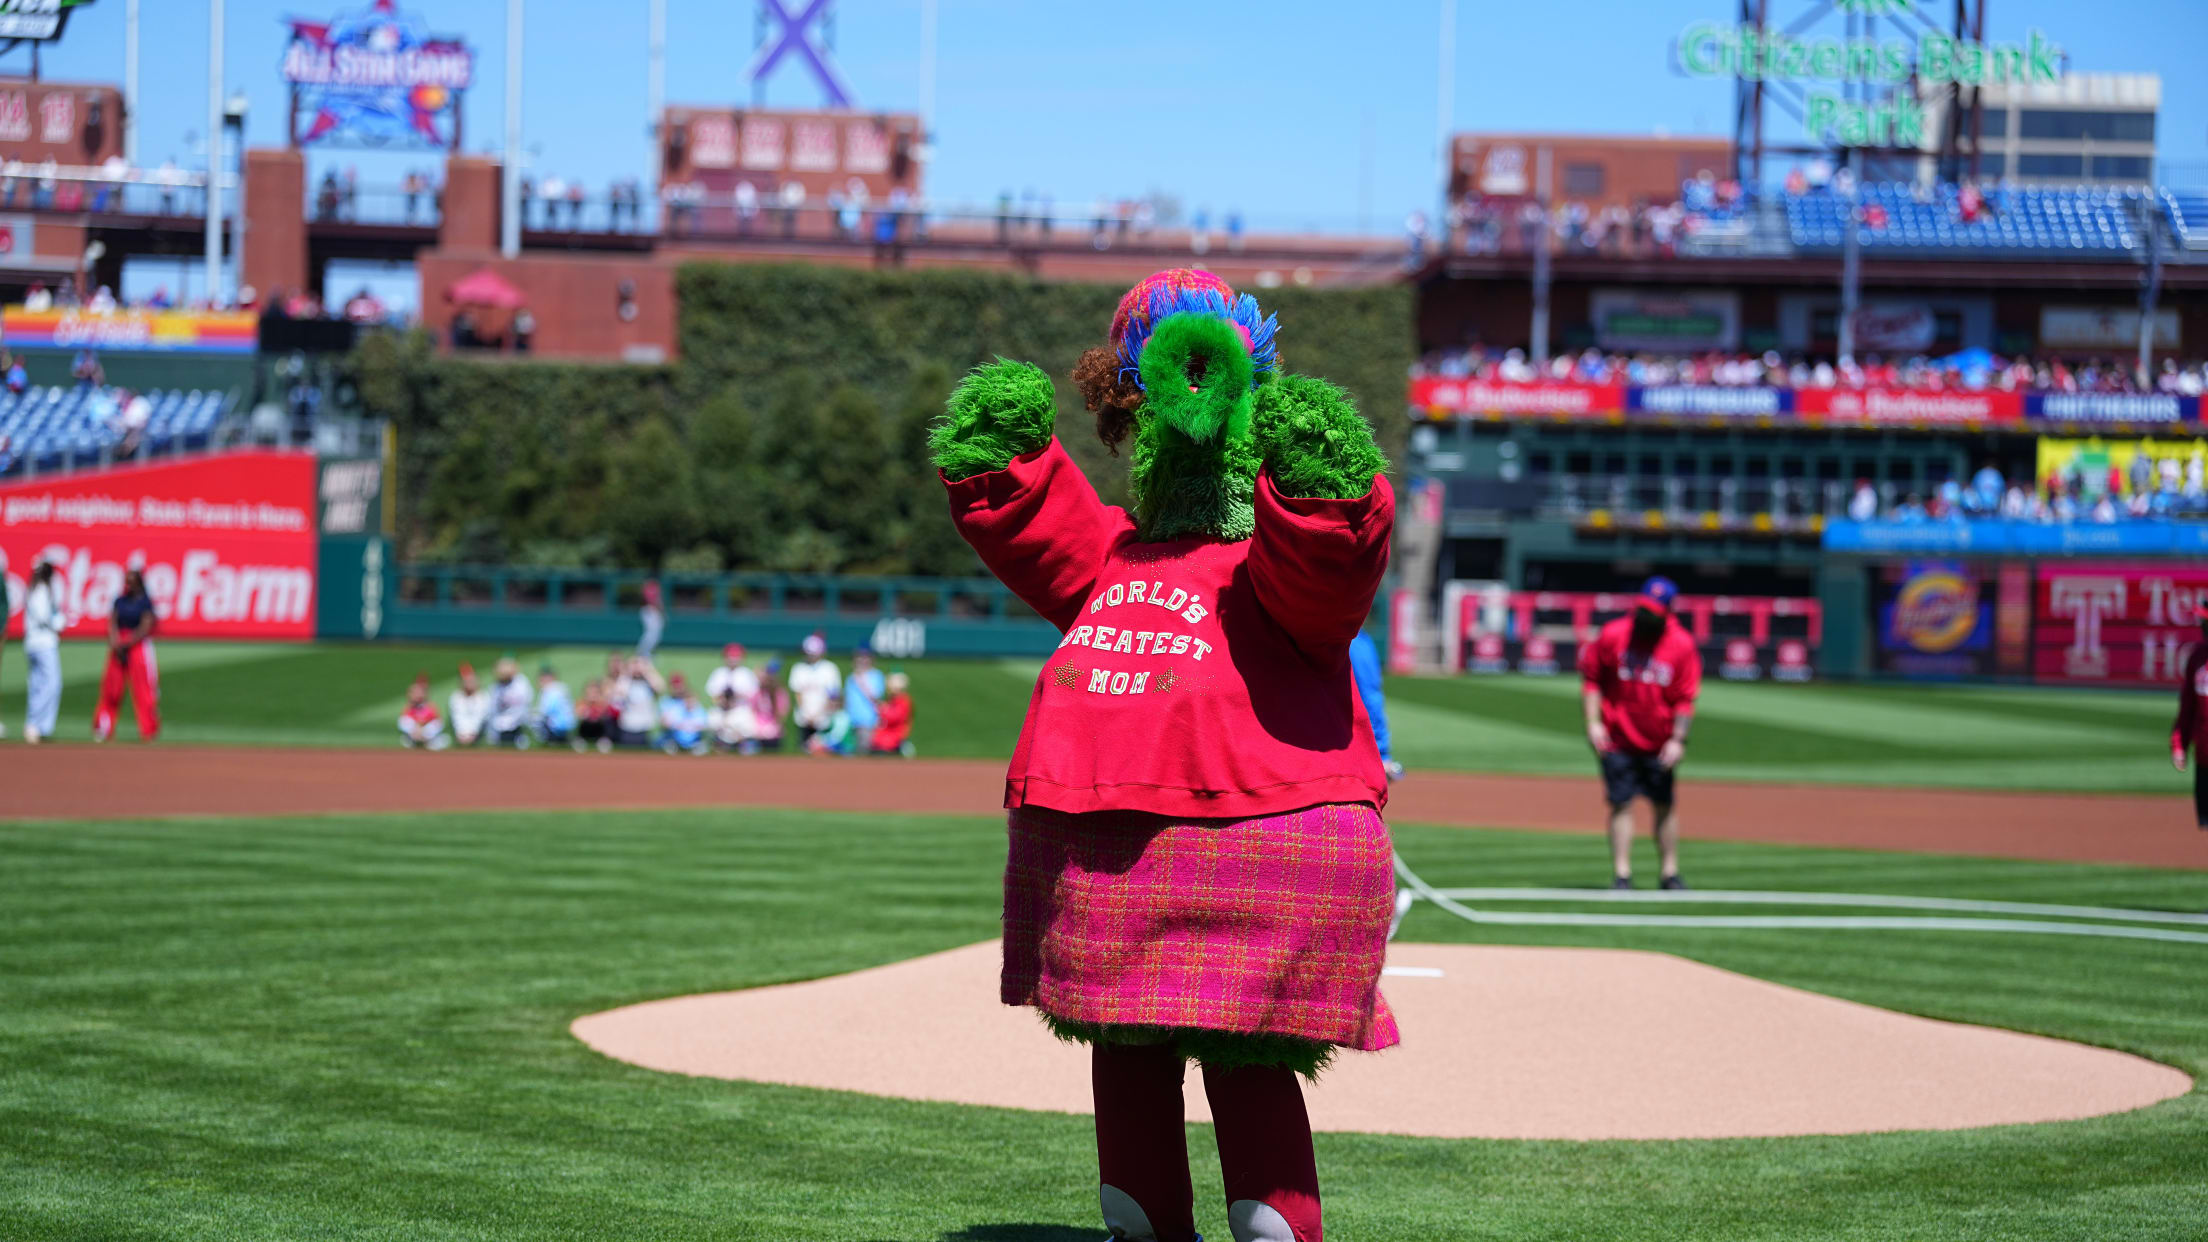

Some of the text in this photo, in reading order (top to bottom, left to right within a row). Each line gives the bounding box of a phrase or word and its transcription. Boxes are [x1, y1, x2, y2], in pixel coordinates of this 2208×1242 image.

[1680, 24, 2062, 85] Citizens Bank
[1804, 92, 1926, 147] Park
[1865, 388, 1990, 421] Budweiser
[4, 493, 53, 526] good
[139, 496, 186, 527] State
[188, 498, 236, 528] Farm
[30, 542, 314, 622] StaeFarm
[1090, 581, 1208, 624] WORLD'S
[1087, 668, 1150, 695] MOM
